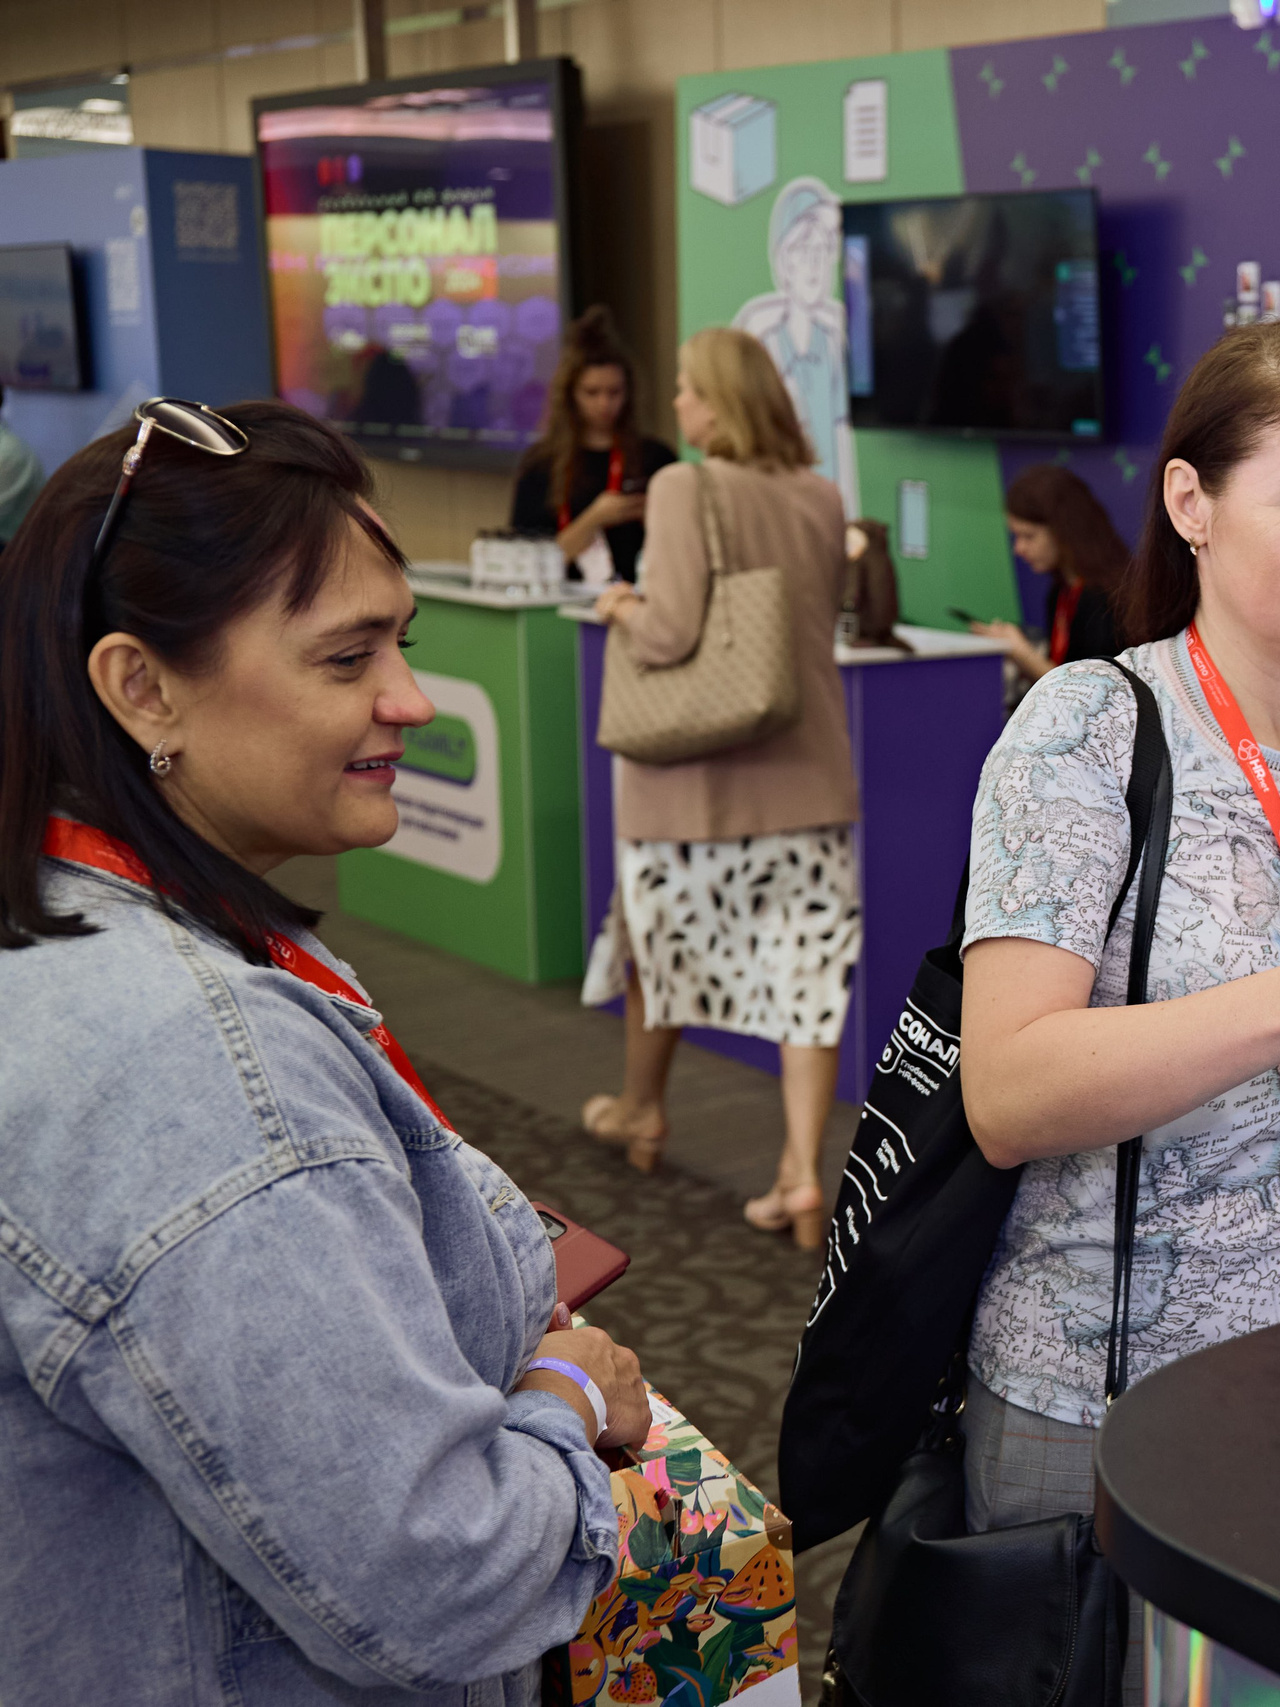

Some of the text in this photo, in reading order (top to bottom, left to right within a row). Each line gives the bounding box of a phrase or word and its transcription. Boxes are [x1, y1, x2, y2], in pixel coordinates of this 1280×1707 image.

[1192, 652, 1209, 677] ЭКСПО
[1249, 759, 1270, 793] HRnet
[897, 1067, 931, 1097] HR-форум
[900, 1059, 940, 1091] Глобальный
